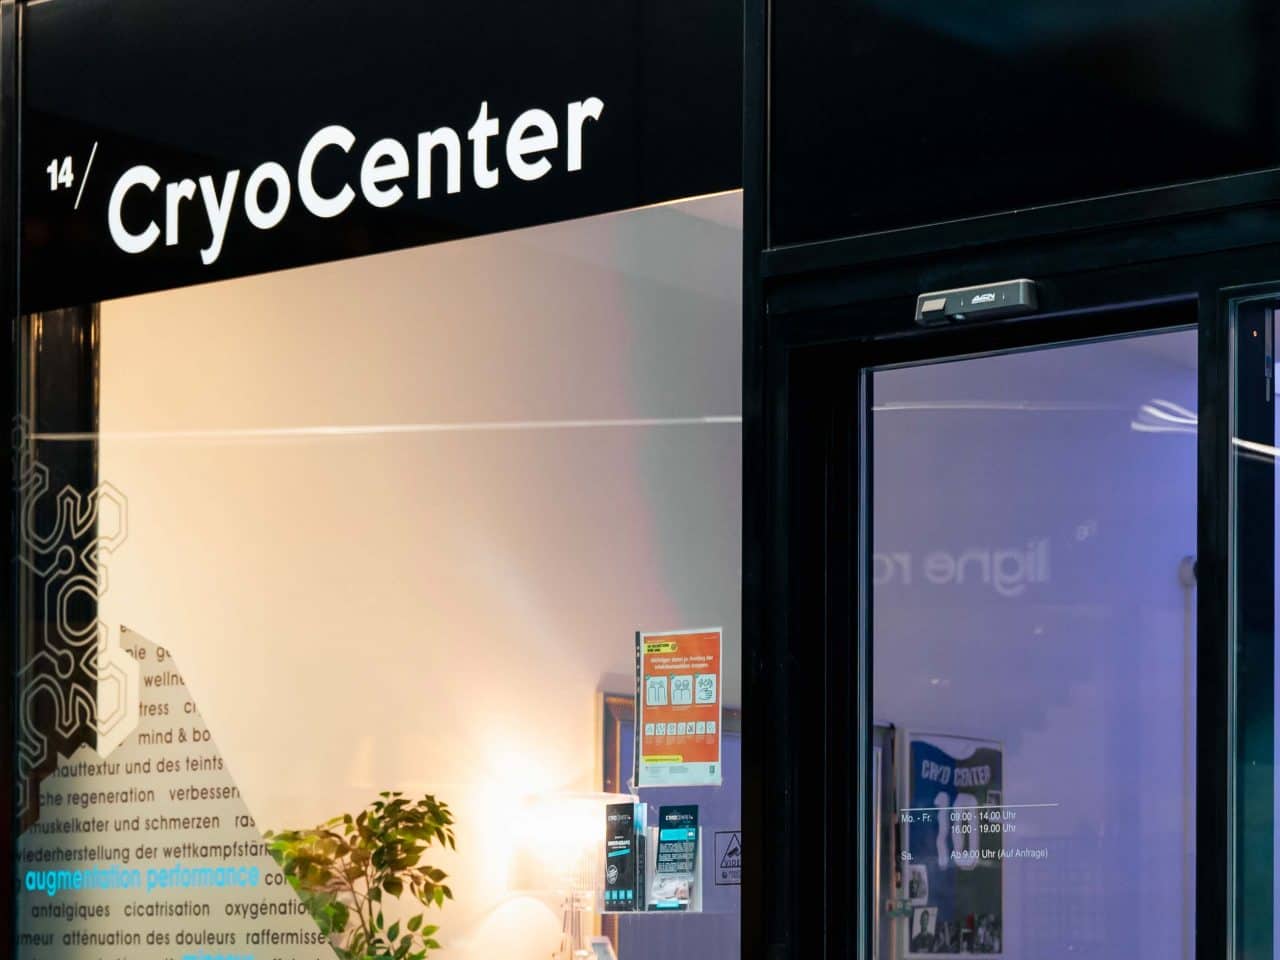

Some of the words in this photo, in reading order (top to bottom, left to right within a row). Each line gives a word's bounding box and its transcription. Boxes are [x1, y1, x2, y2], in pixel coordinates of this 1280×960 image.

[108, 96, 604, 265] CryoCenter
[922, 760, 950, 785] CRYO
[954, 765, 990, 786] CENTER
[980, 811, 1000, 820] 14.00
[1003, 811, 1016, 820] Uhr
[980, 825, 1000, 833] 19.00
[1003, 825, 1016, 833] Uhr
[982, 849, 995, 858] Uhr
[25, 867, 141, 896] augmentation
[146, 864, 259, 892] performance
